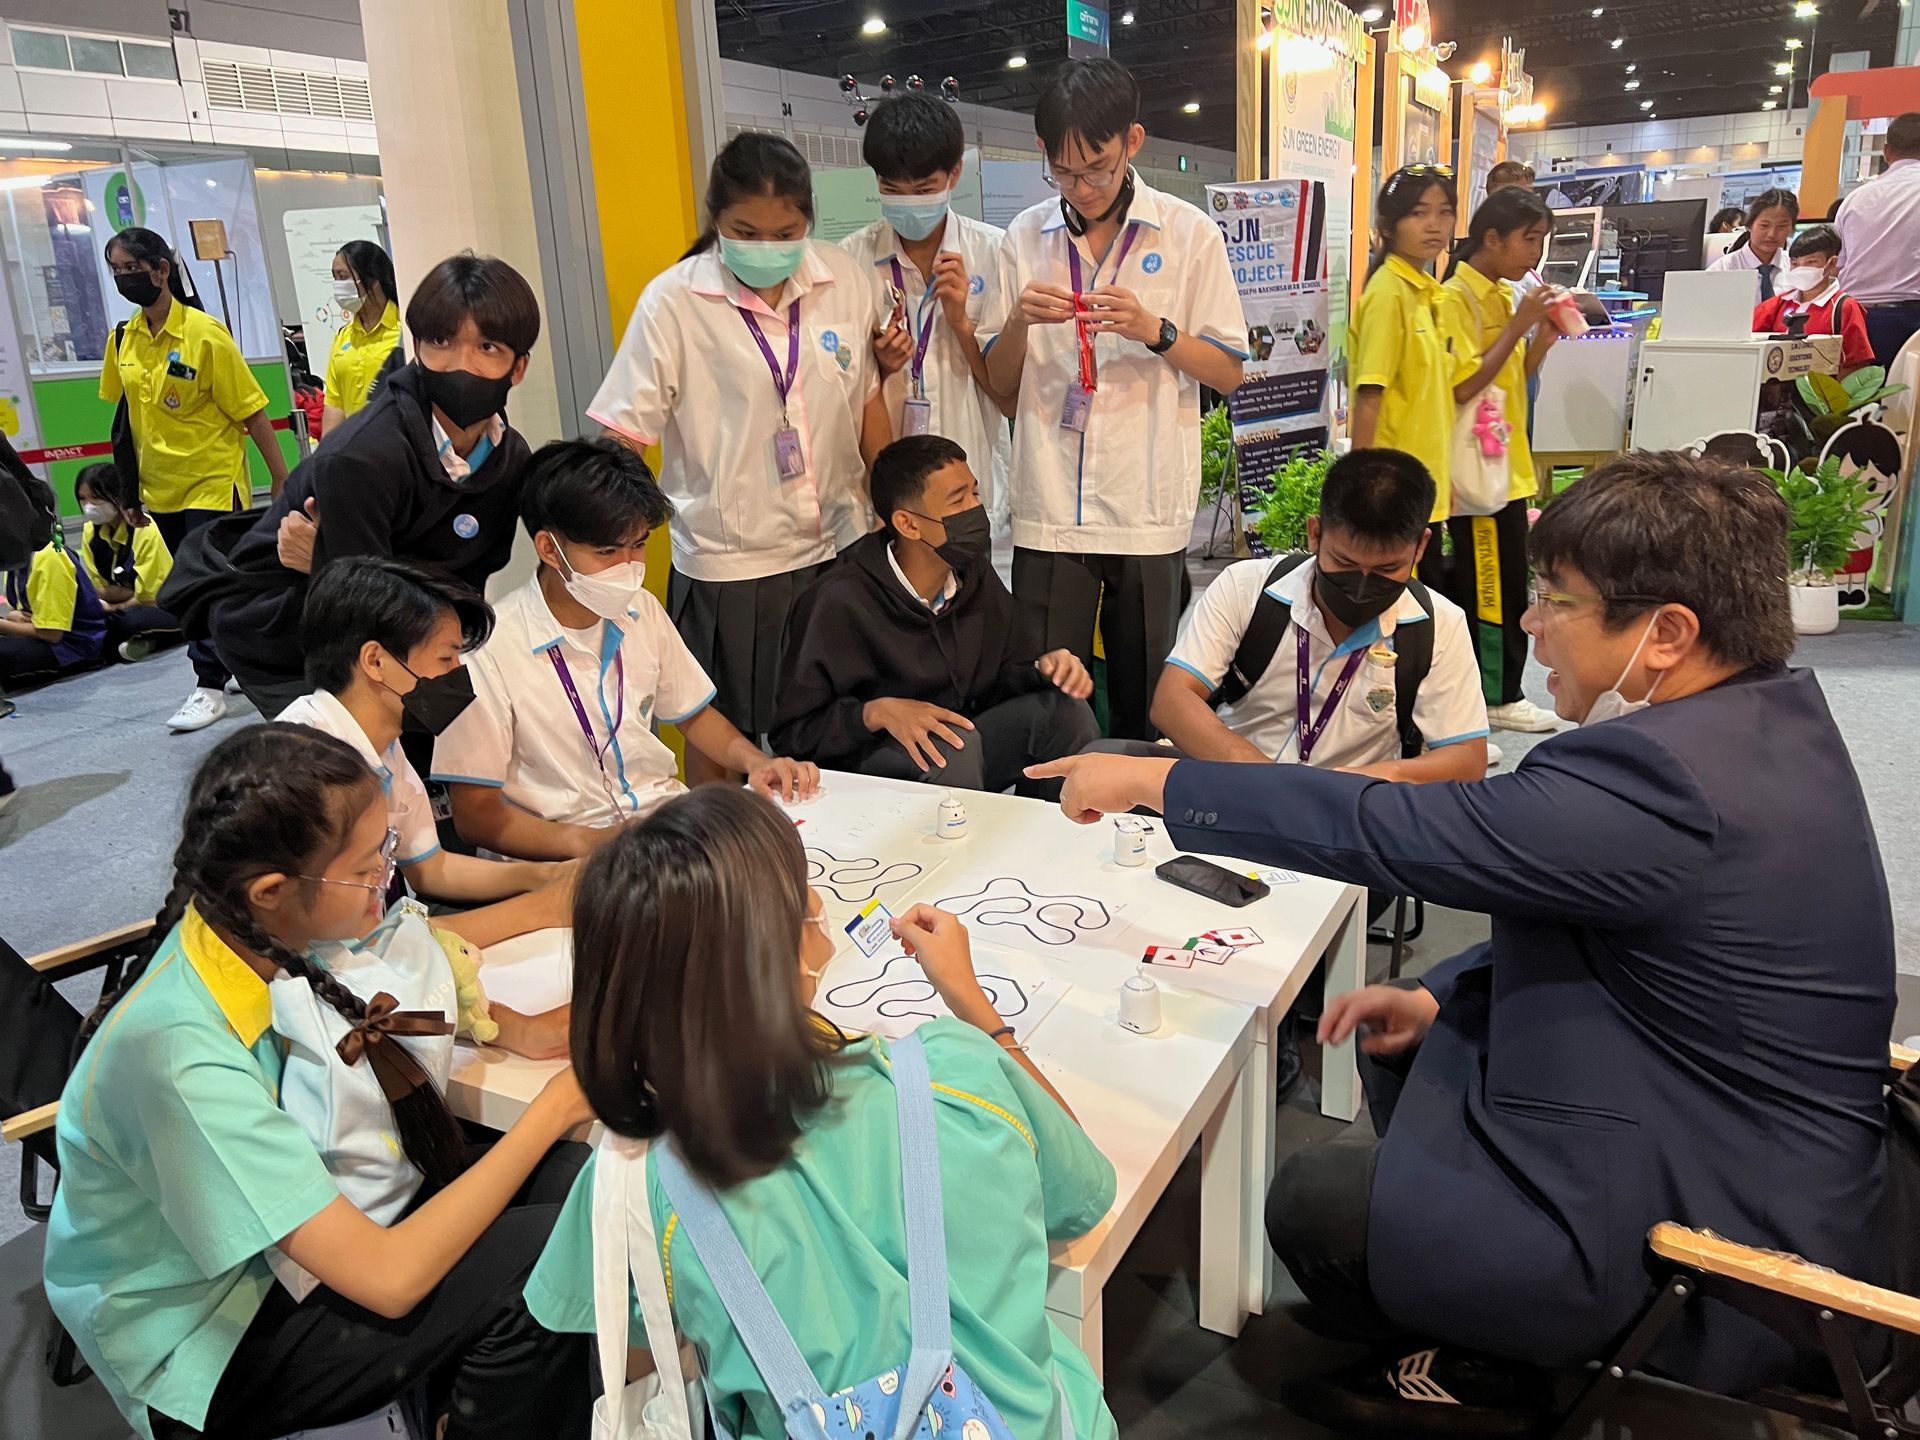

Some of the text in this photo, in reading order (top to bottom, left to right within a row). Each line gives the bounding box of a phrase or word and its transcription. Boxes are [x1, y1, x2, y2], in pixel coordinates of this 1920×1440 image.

[1296, 129, 1318, 155] GREEN
[1318, 136, 1341, 160] ENERGY
[1216, 218, 1260, 244] SJN
[1227, 243, 1275, 263] ESCUE
[1232, 264, 1285, 284] OJECT
[1238, 286, 1257, 297] OSEPH
[1301, 281, 1322, 289] SCHOOL
[1236, 428, 1280, 446] OBJECTIVE
